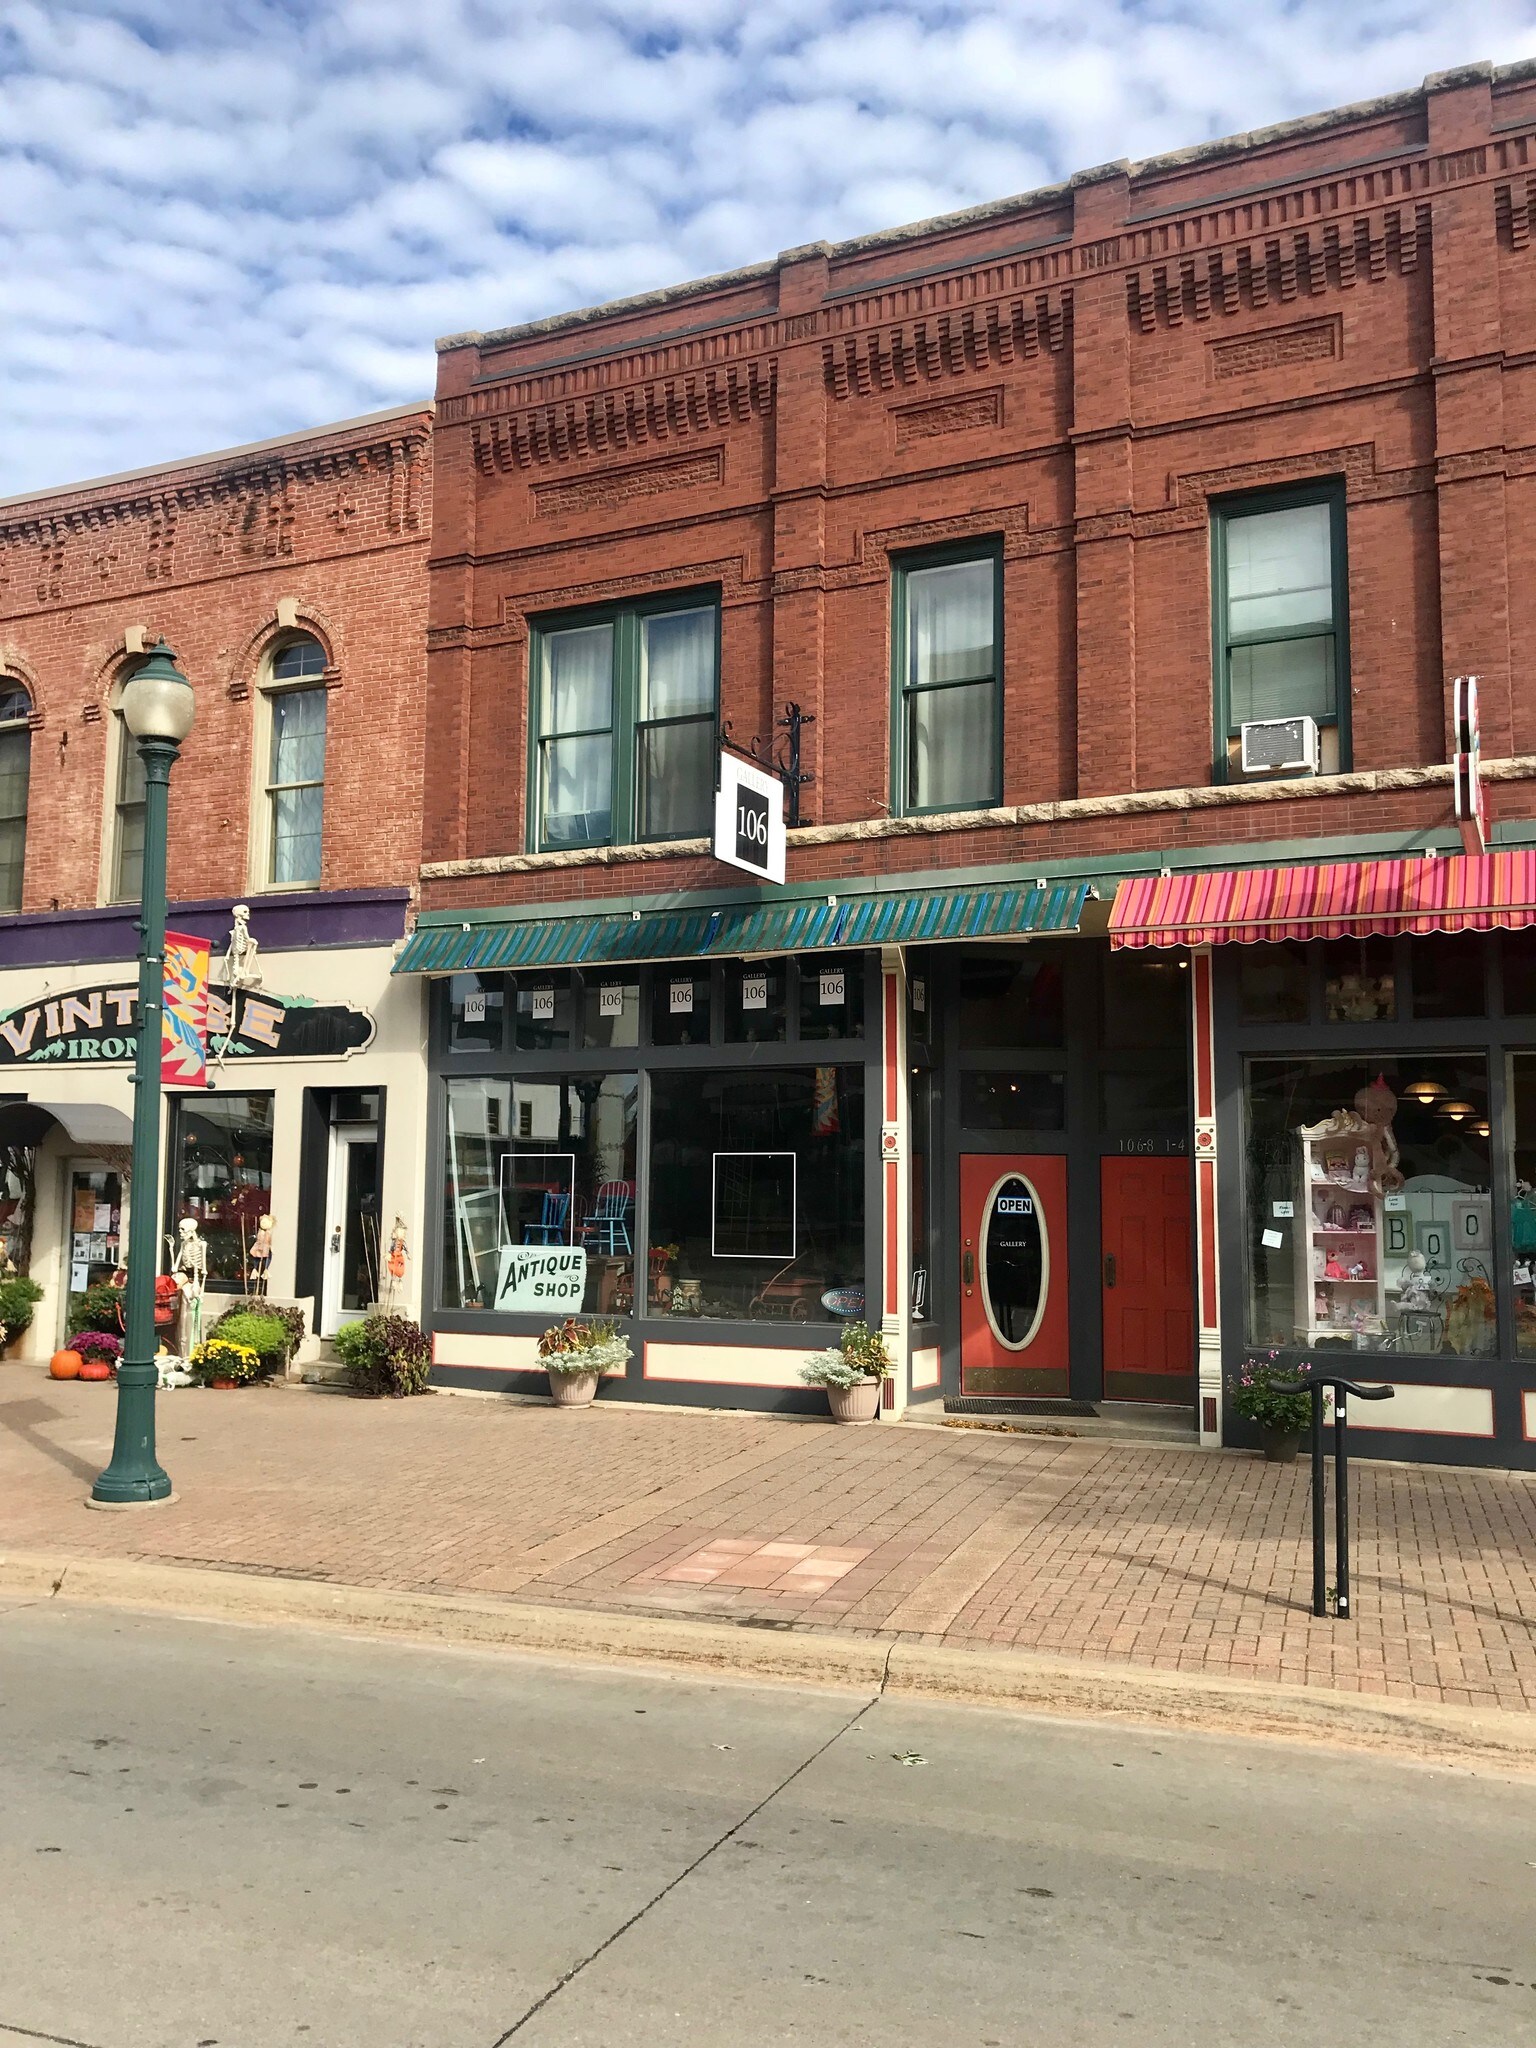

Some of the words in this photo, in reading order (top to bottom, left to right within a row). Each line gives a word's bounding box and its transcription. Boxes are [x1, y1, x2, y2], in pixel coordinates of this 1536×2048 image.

[738, 806, 768, 845] 106
[744, 985, 766, 999] 106
[821, 980, 844, 995] 106
[914, 988, 925, 1002] 106
[534, 996, 553, 1010] 106
[601, 992, 622, 1007] 106
[672, 989, 692, 1003] 106
[466, 999, 485, 1014] 106
[0, 988, 286, 1057] VINTGE
[1000, 1200, 1031, 1212] OPEN
[500, 1255, 583, 1300] ANTIQUE
[533, 1282, 581, 1298] SHOP
[826, 1295, 865, 1309] OPE
